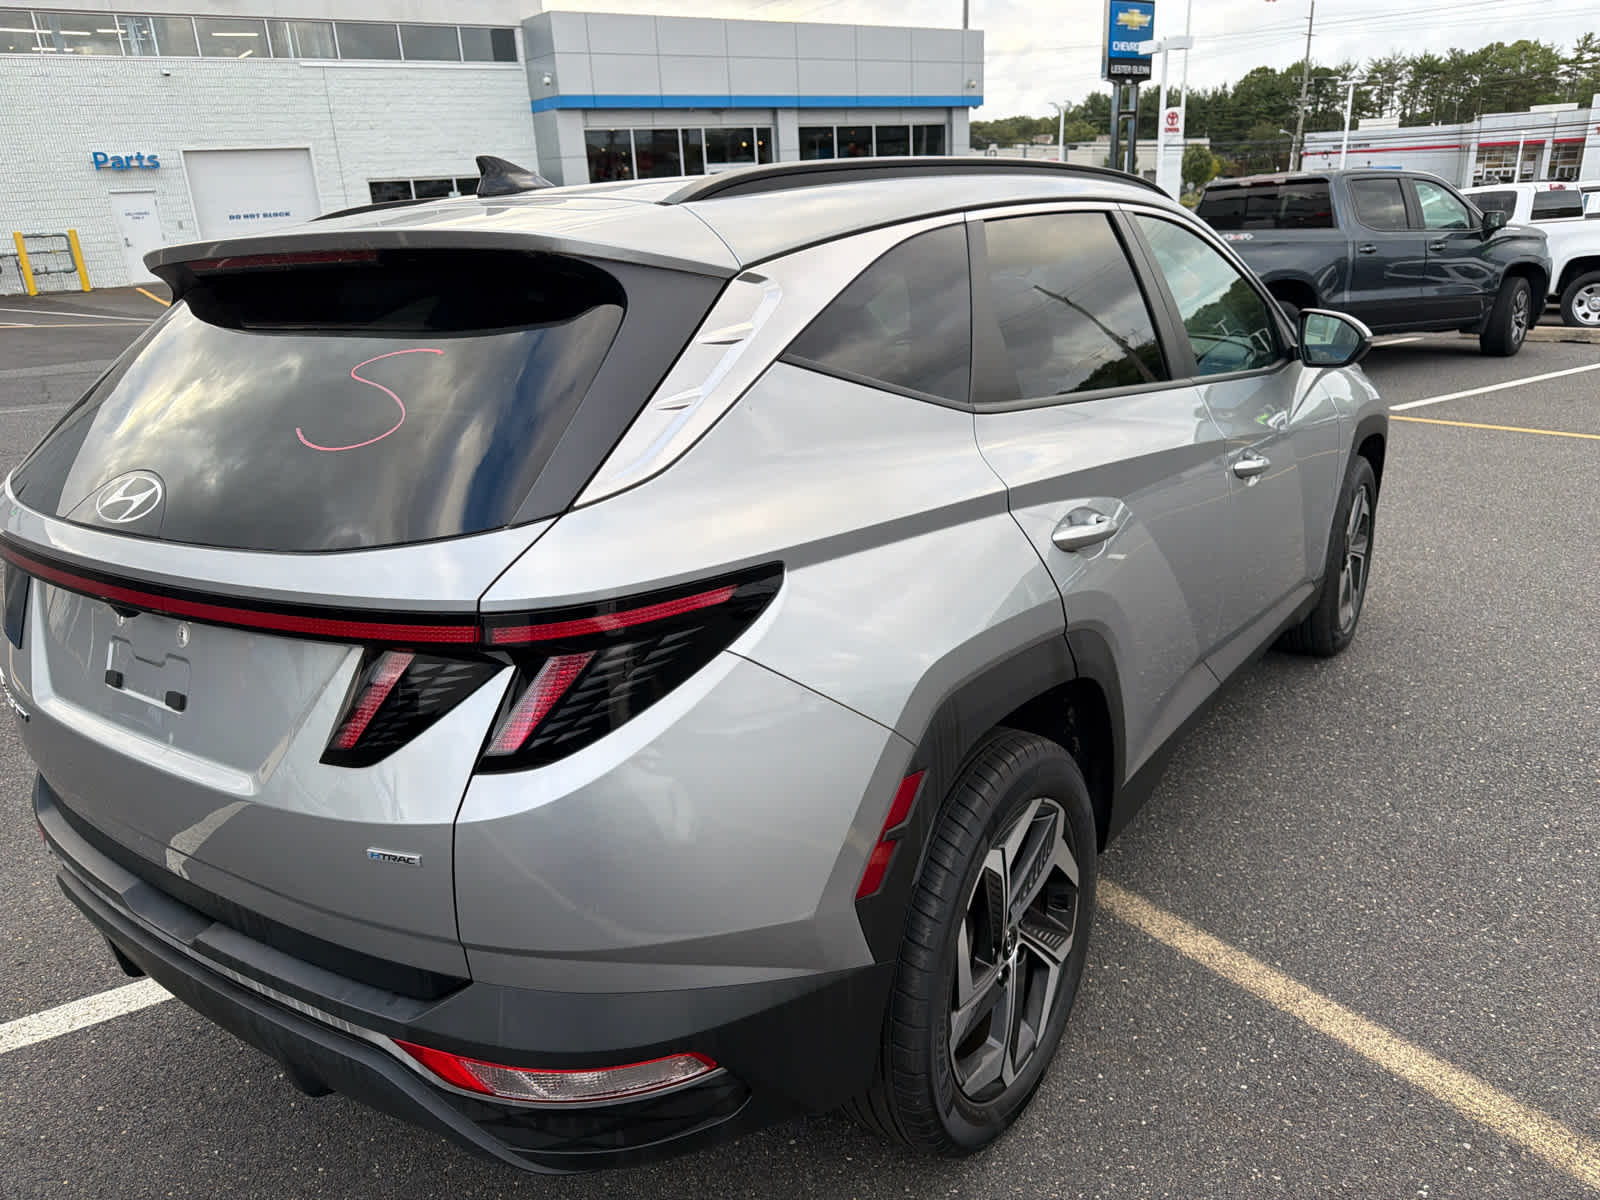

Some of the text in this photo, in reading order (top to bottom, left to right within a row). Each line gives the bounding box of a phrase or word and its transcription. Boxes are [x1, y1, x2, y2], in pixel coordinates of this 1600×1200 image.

[92, 151, 161, 171] Parts
[295, 348, 445, 451] S
[369, 851, 417, 865] HTRAC
